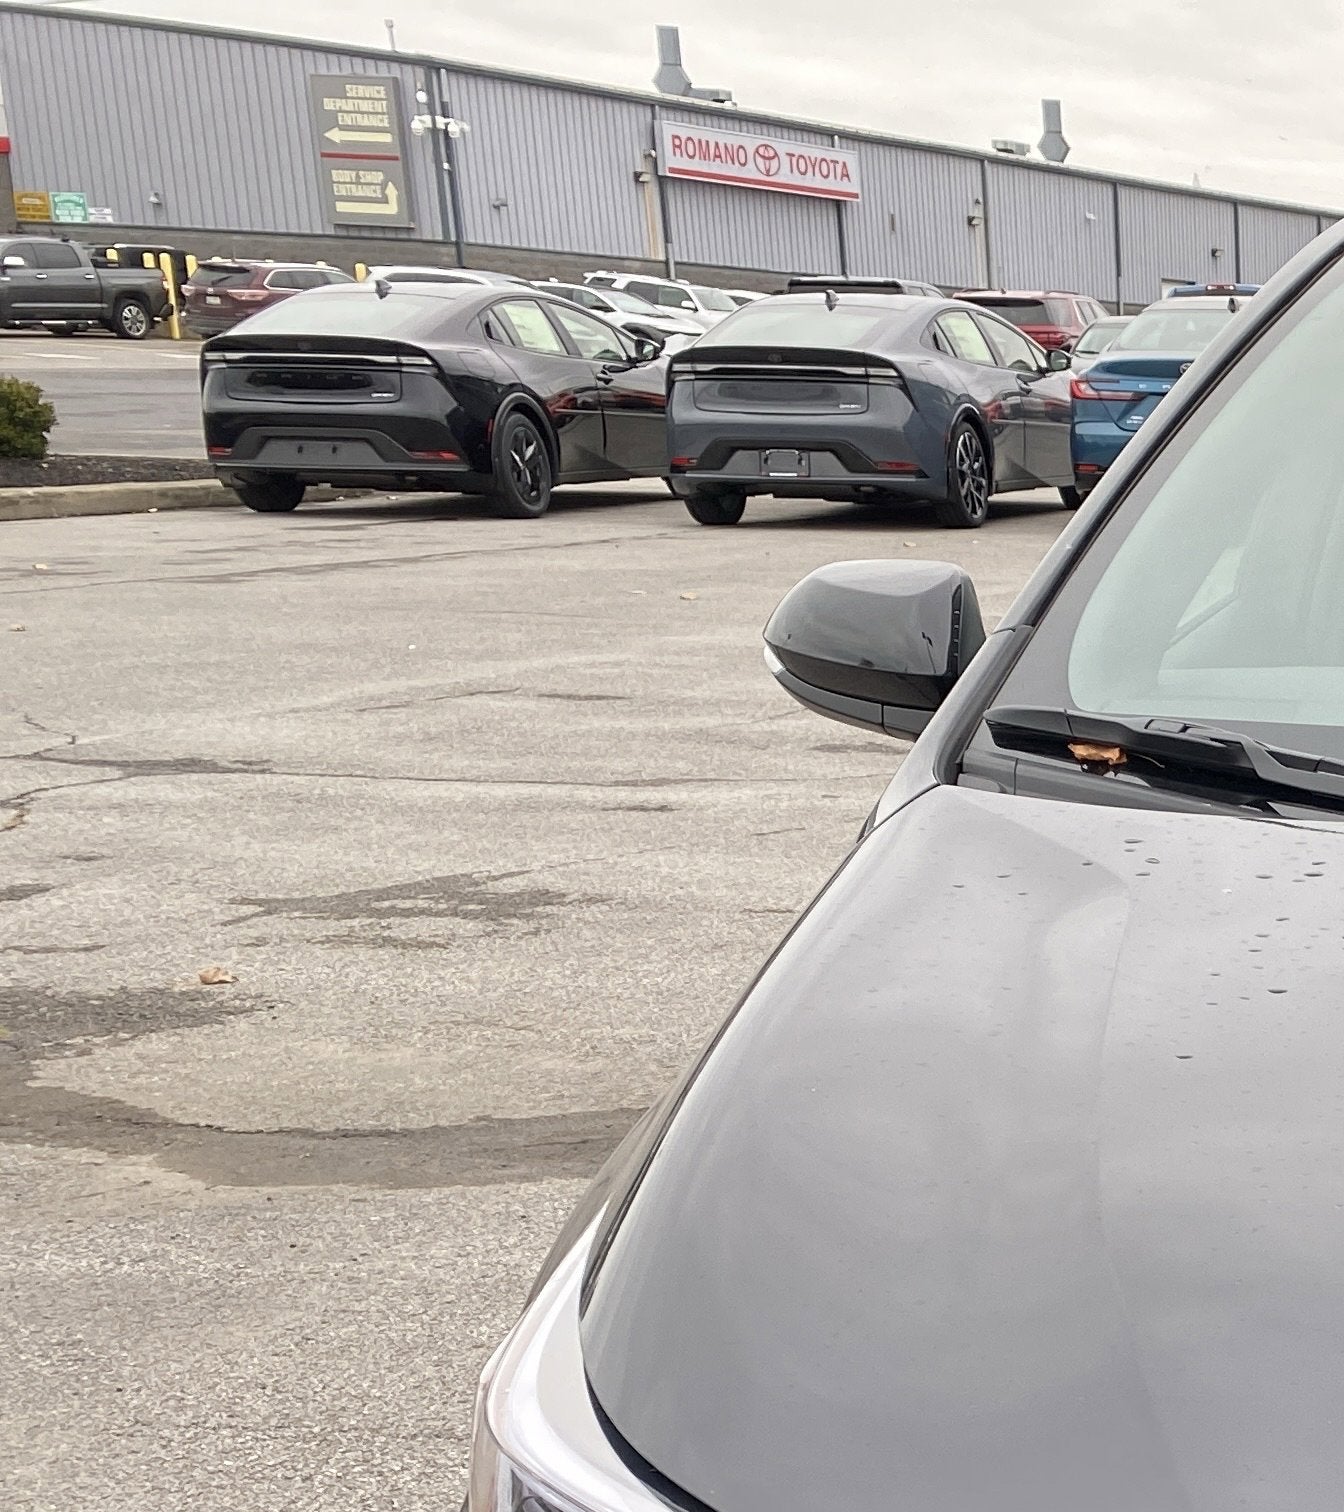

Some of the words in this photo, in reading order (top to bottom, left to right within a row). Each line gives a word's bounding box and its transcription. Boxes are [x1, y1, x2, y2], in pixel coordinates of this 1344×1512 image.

[345, 84, 387, 99] SERVICE
[323, 97, 388, 113] DEPARTMENT
[337, 112, 390, 128] ENTRANCE
[671, 134, 748, 168] ROMANO
[785, 152, 851, 183] TOYOTA
[359, 170, 384, 184] SHOP
[333, 183, 382, 198] ENTRANCE
